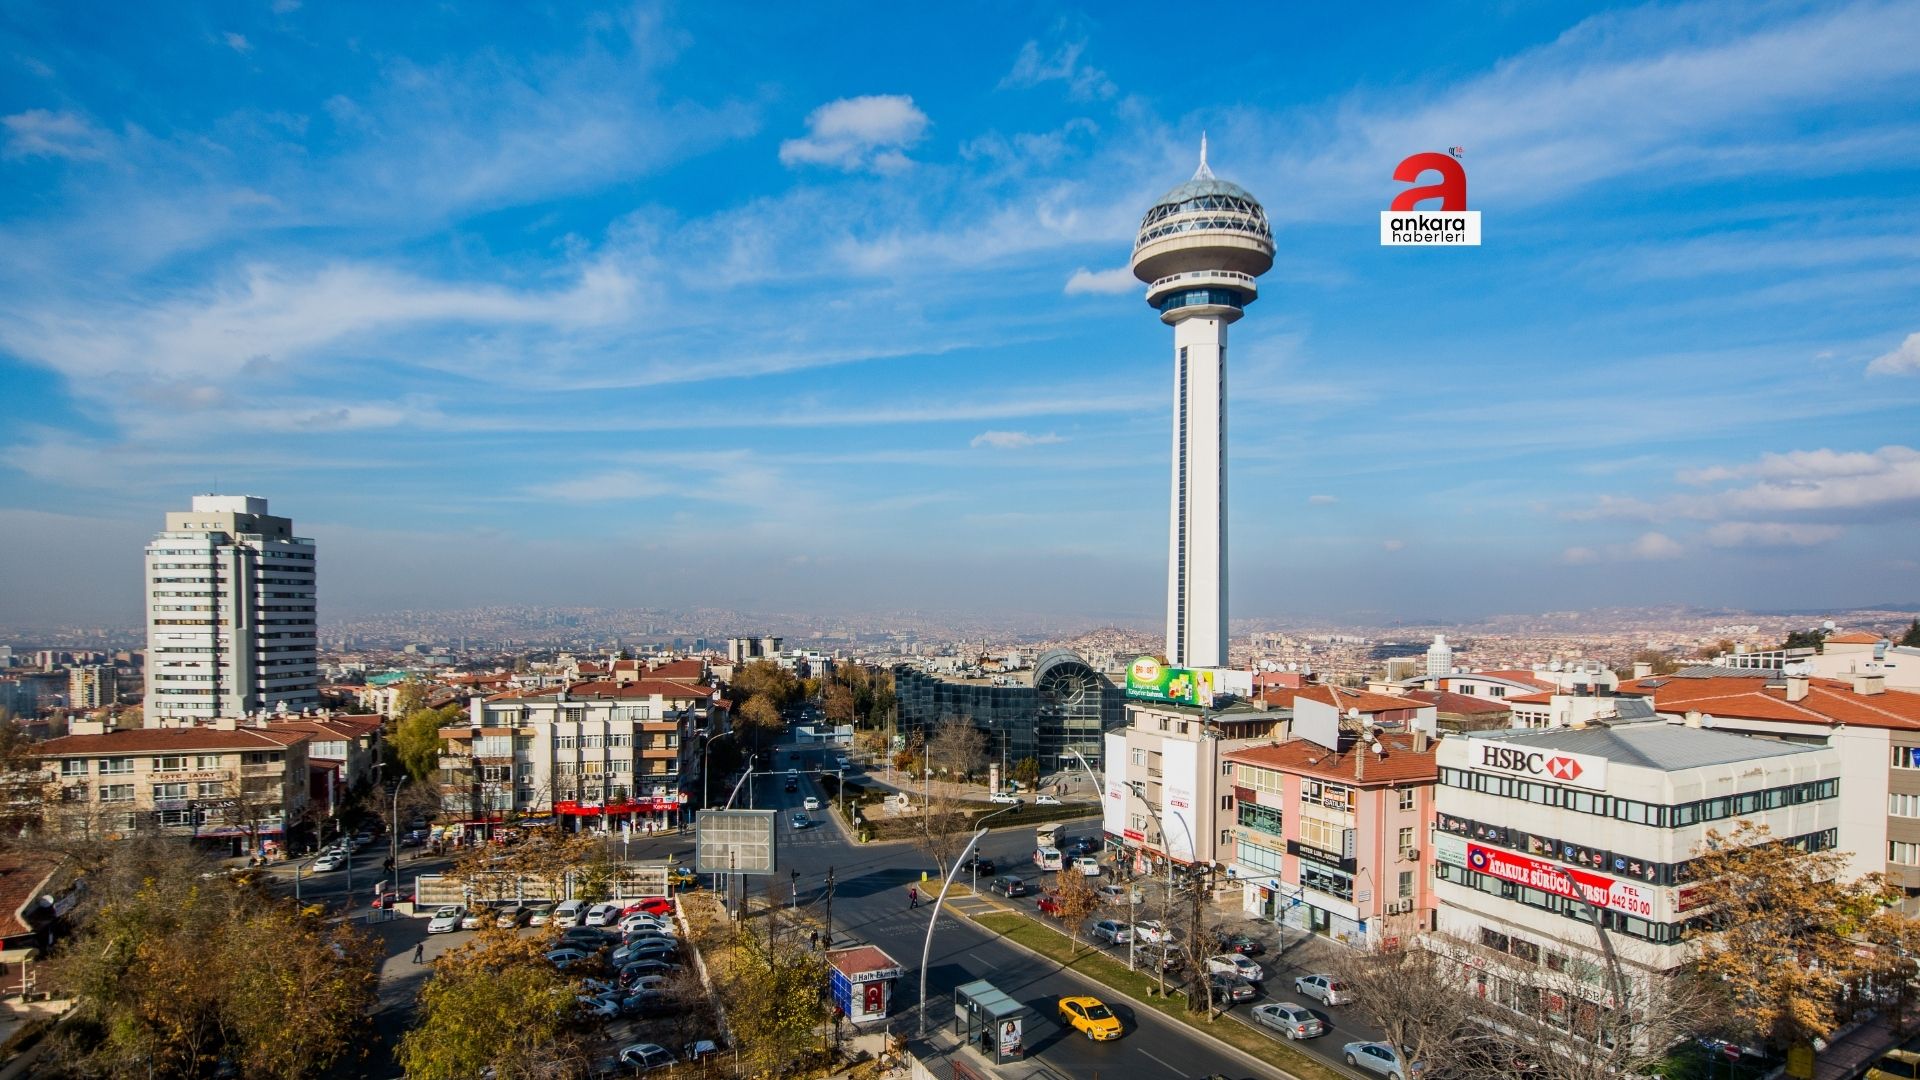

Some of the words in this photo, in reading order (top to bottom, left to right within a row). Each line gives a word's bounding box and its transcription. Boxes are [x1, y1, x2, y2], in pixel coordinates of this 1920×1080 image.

[1482, 744, 1544, 775] HSBC
[1488, 857, 1530, 883] ATAKULE
[1530, 868, 1571, 895] SÜRÜCÜ
[1622, 885, 1640, 897] TEL
[1611, 894, 1626, 909] 442
[1628, 898, 1638, 912] 50
[1640, 900, 1651, 916] 00
[858, 973, 873, 981] Halk
